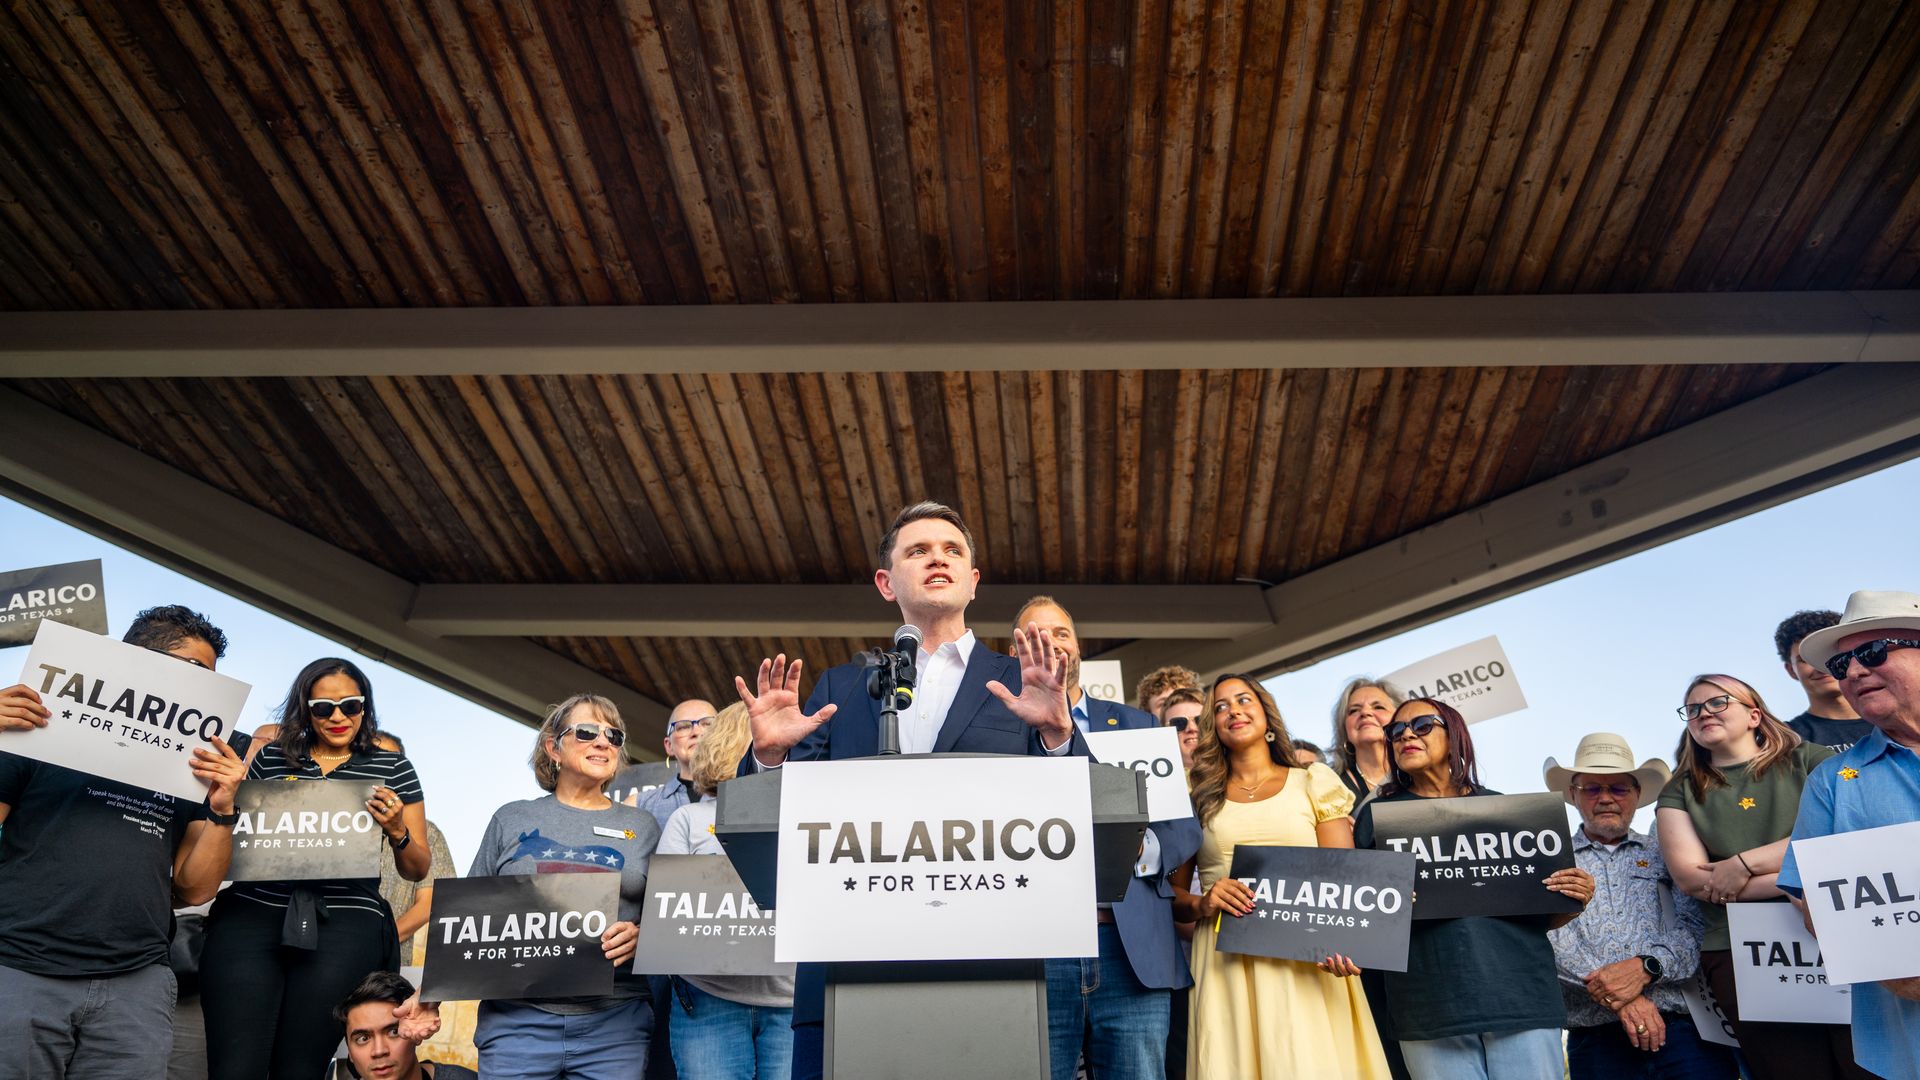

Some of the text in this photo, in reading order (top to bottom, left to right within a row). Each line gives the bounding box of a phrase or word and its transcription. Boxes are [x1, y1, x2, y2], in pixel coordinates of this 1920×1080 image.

[0, 583, 97, 612] ARICO
[0, 608, 62, 623] OR TEXAS
[1408, 661, 1505, 700] ALARICO
[39, 663, 224, 743] TALARICO
[1451, 688, 1483, 703] TEXAS
[78, 713, 171, 749] FOR TEXAS
[91, 790, 107, 798] speak
[108, 793, 126, 801] tonight
[232, 810, 374, 835] ALARICO
[254, 838, 333, 849] FOR TEXAS
[797, 817, 1076, 864] TALARICO
[1386, 829, 1562, 863] TALARICO
[1435, 865, 1521, 879] FOR TEXAS
[868, 874, 1006, 892] FOR TEXAS
[1818, 872, 1920, 911] TAL
[1237, 877, 1402, 914] TALARICO
[438, 910, 607, 944] TALARICO
[1272, 909, 1355, 927] FOR TEXAS
[693, 925, 777, 936] FOR TEXAS
[478, 945, 561, 960] FOR TEXAS
[1795, 974, 1827, 985] FOR
